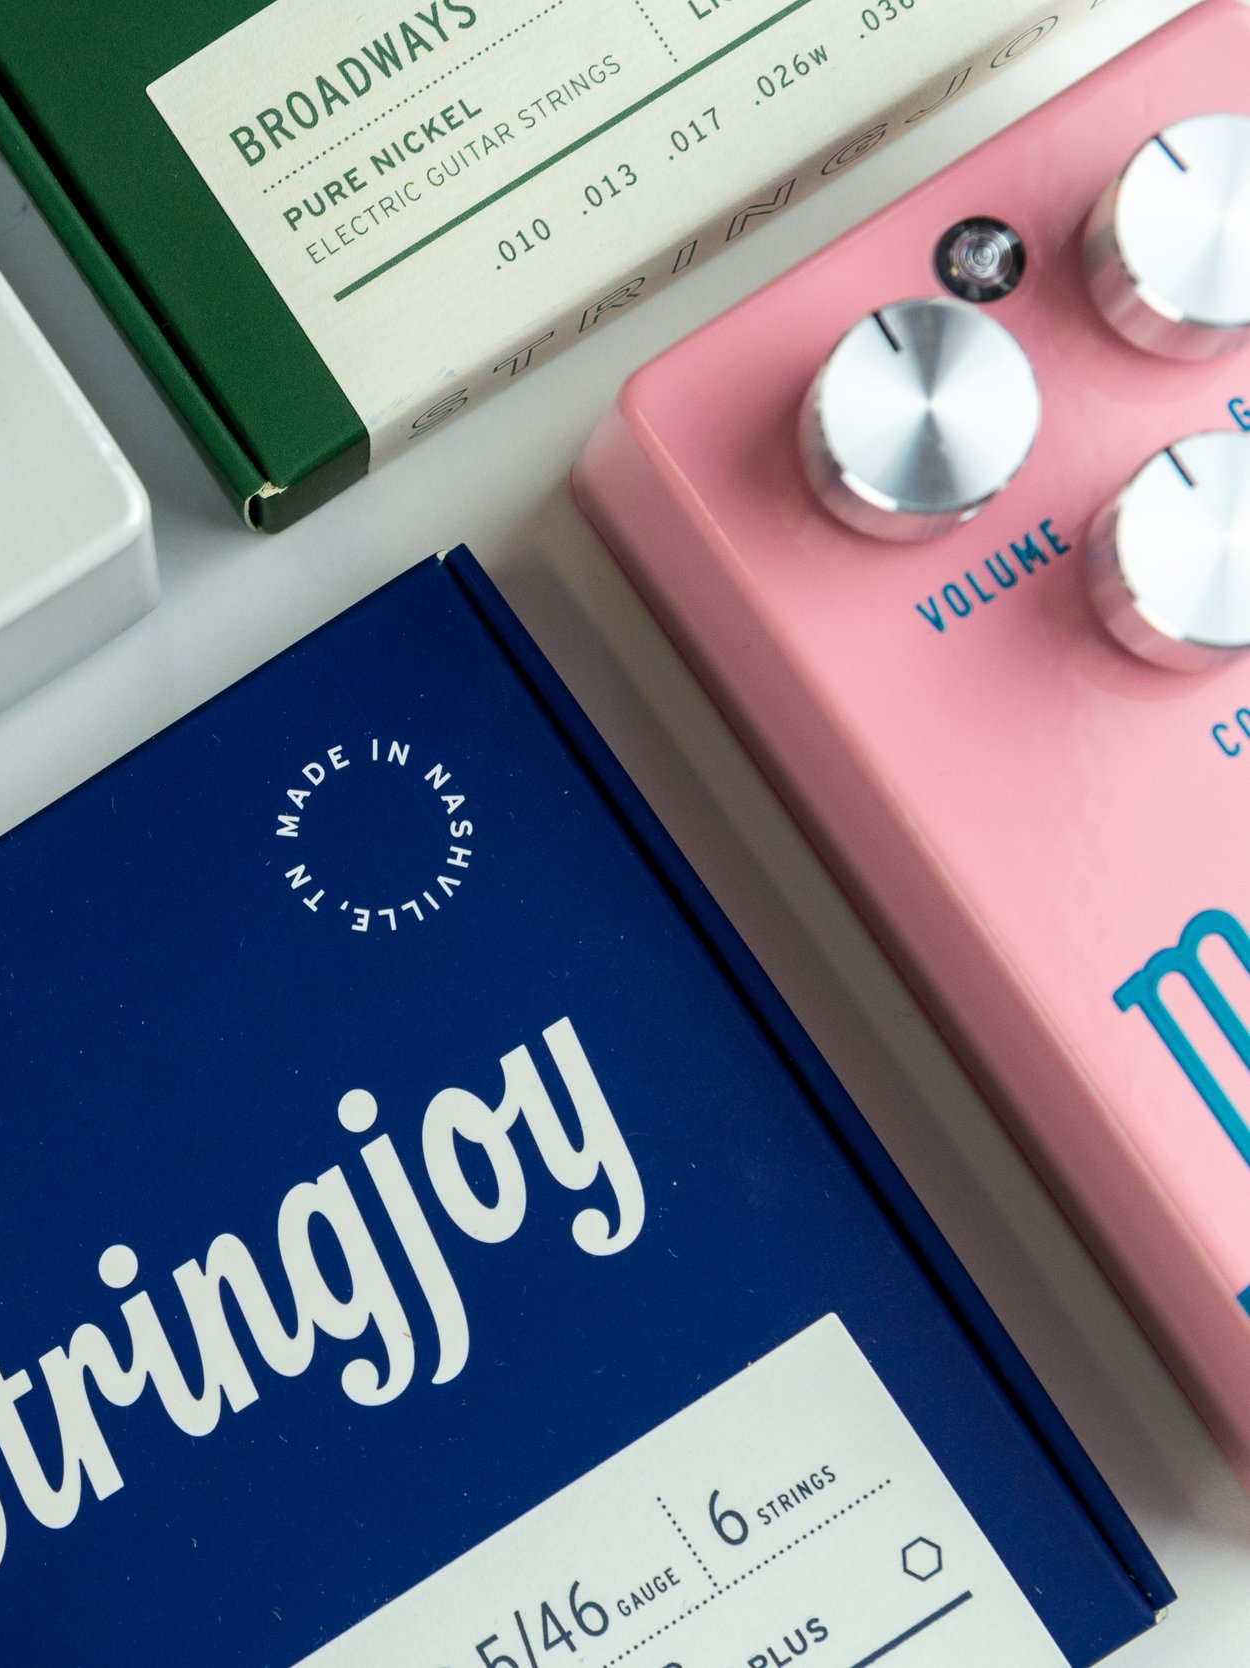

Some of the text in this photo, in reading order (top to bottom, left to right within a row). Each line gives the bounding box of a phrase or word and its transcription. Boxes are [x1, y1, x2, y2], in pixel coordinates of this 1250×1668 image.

[229, 0, 477, 167] BROADWAYS
[282, 99, 483, 231] PURE NICKEL
[305, 54, 622, 264] ELECTRIC GUITAR STRINGS
[496, 218, 551, 271] .010
[582, 164, 638, 216] .013
[667, 106, 724, 161] .017
[915, 517, 1071, 633] VOLUME
[275, 738, 473, 933] MADE IN NASHVILLE, TN
[616, 1566, 681, 1617] GAUGE
[708, 1489, 749, 1546] 6
[756, 1465, 837, 1525] STRINGS
